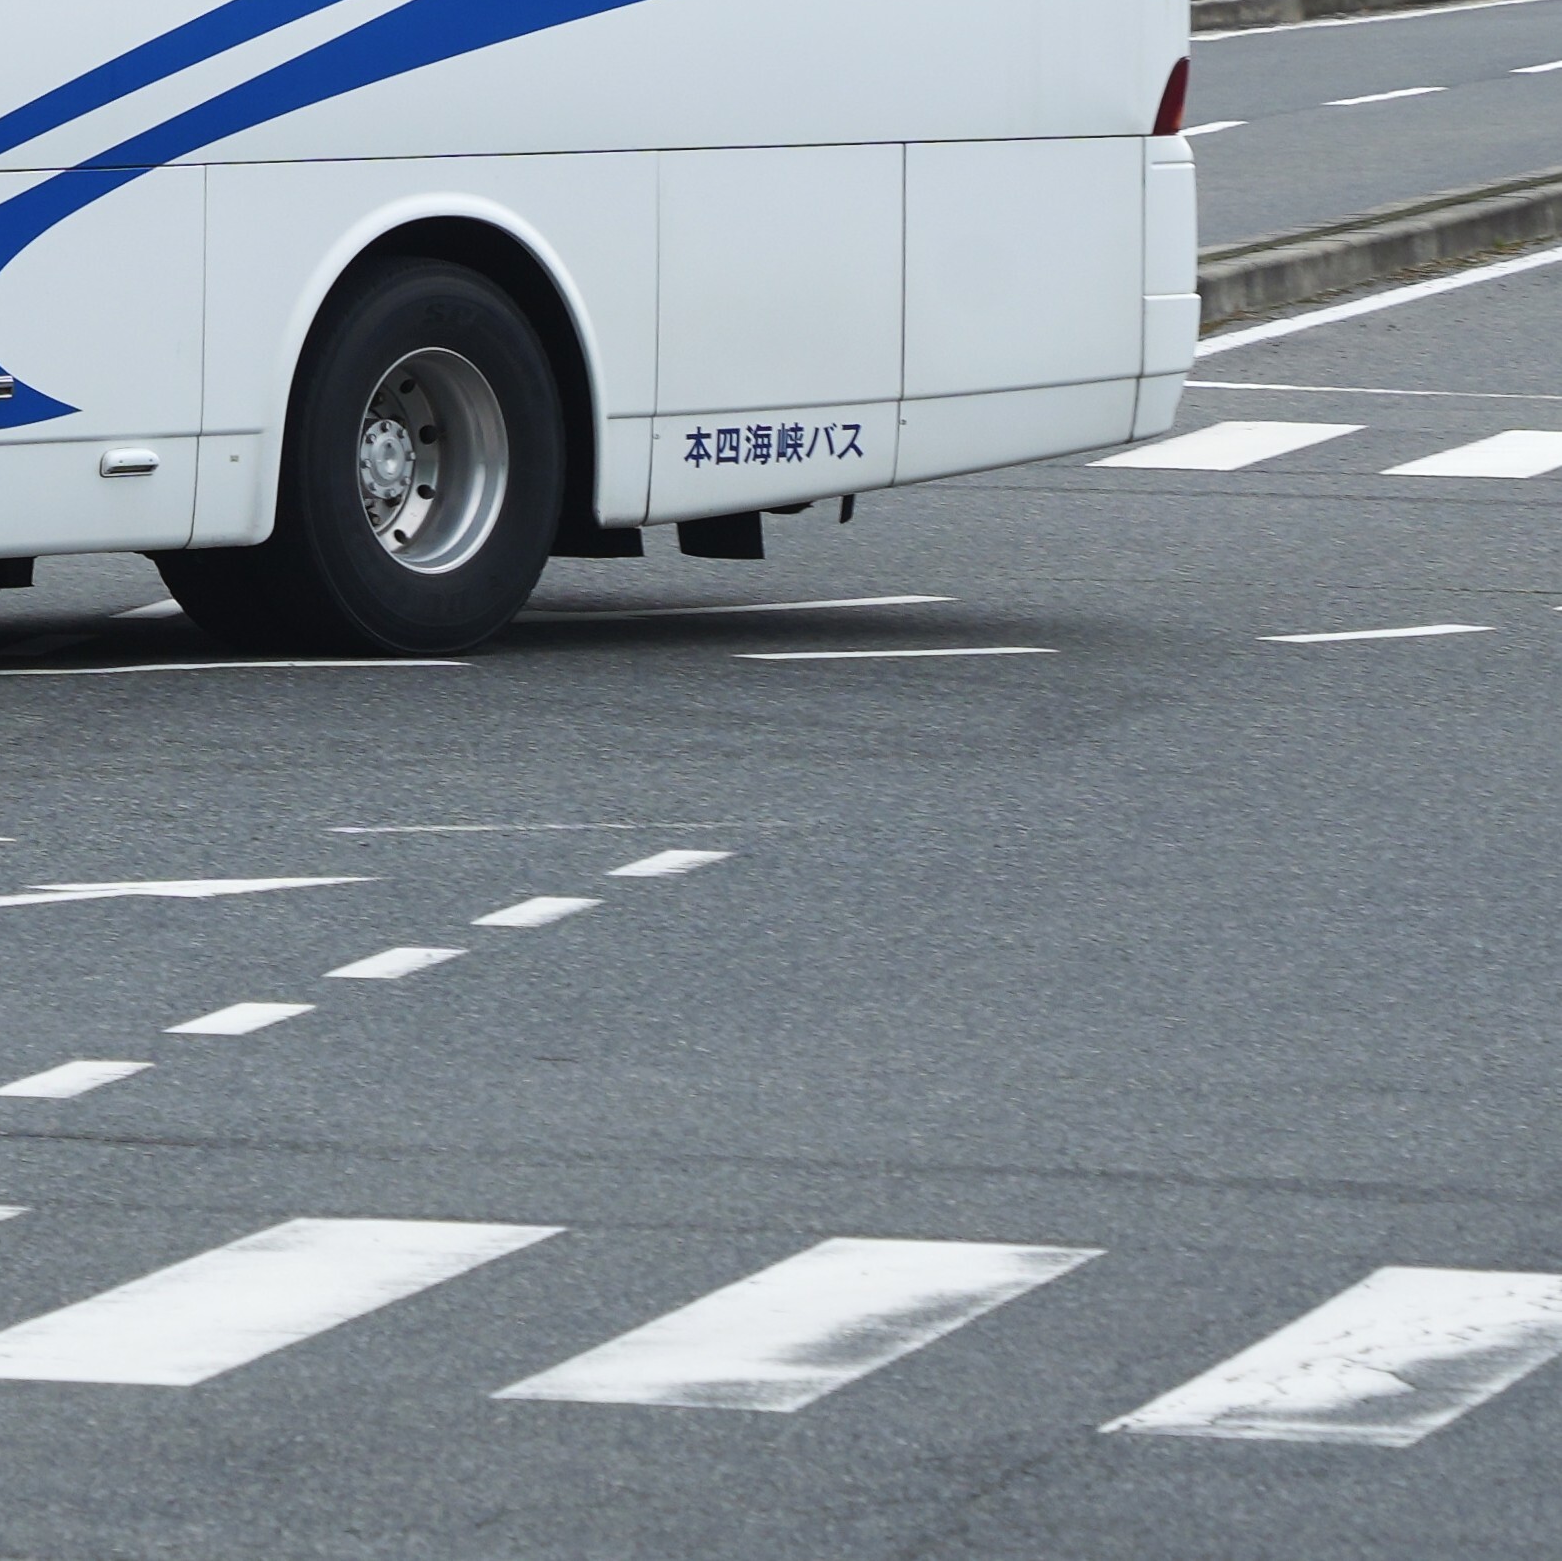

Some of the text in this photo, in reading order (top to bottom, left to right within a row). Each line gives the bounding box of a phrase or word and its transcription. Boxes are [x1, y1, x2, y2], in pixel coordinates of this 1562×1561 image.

[684, 422, 863, 467] 本四海峡バス
